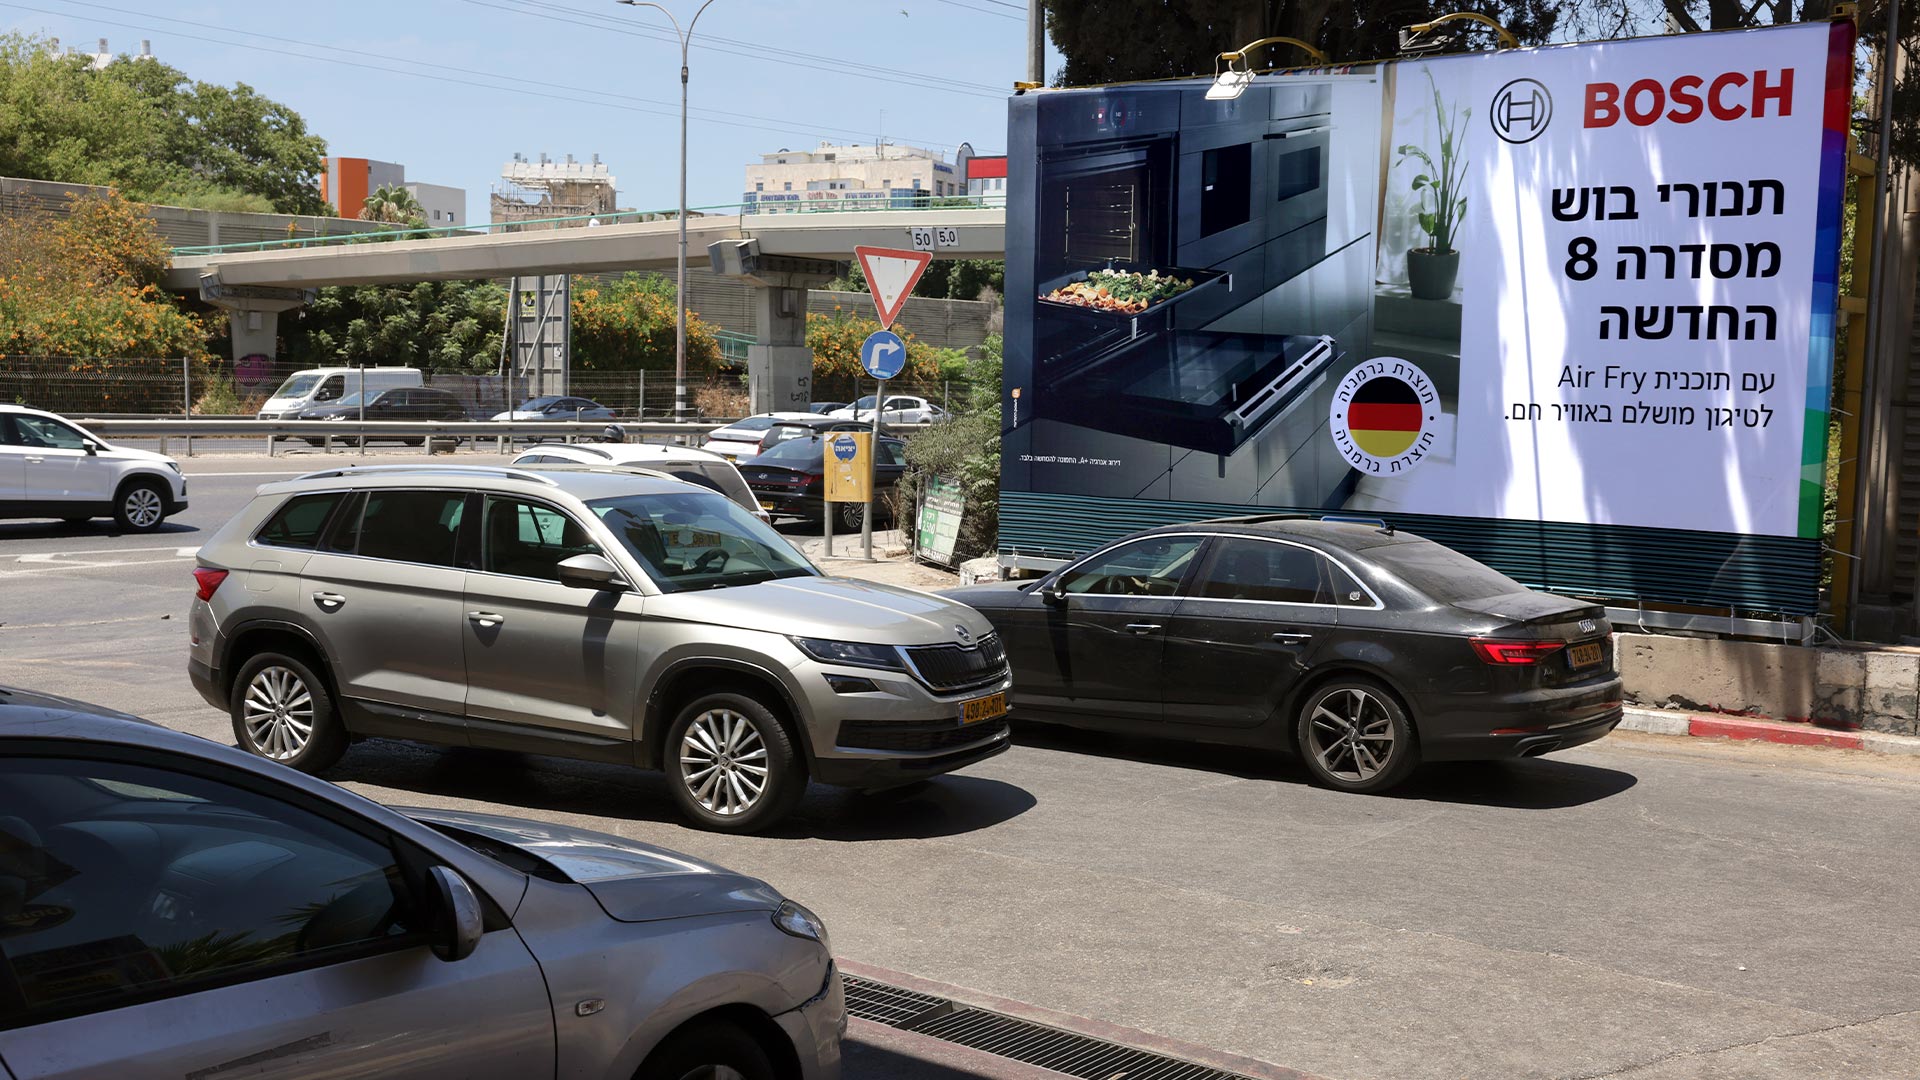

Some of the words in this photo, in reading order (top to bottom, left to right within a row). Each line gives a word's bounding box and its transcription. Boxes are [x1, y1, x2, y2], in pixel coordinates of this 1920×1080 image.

[1583, 68, 1795, 129] BOSCH
[1551, 185, 1639, 222] בוש
[1657, 179, 1785, 218] תנורי
[939, 231, 955, 243] 5.0
[1564, 236, 1598, 281] 8
[1616, 241, 1782, 281] מסדרה
[1599, 305, 1778, 341] החדשה
[1338, 362, 1385, 403] גרמניה
[1392, 363, 1434, 404] תוצרת
[1558, 365, 1595, 388] Air
[1604, 366, 1647, 394] Fry
[1654, 371, 1730, 392] תוכנית
[1741, 372, 1775, 394] עם
[1504, 402, 1542, 421] חם.
[1551, 402, 1612, 423] באוויר
[1622, 402, 1695, 425] מושלם
[1707, 404, 1774, 431] לטיגון
[1335, 429, 1380, 472] גרמניה
[1391, 432, 1434, 472] תוצרת
